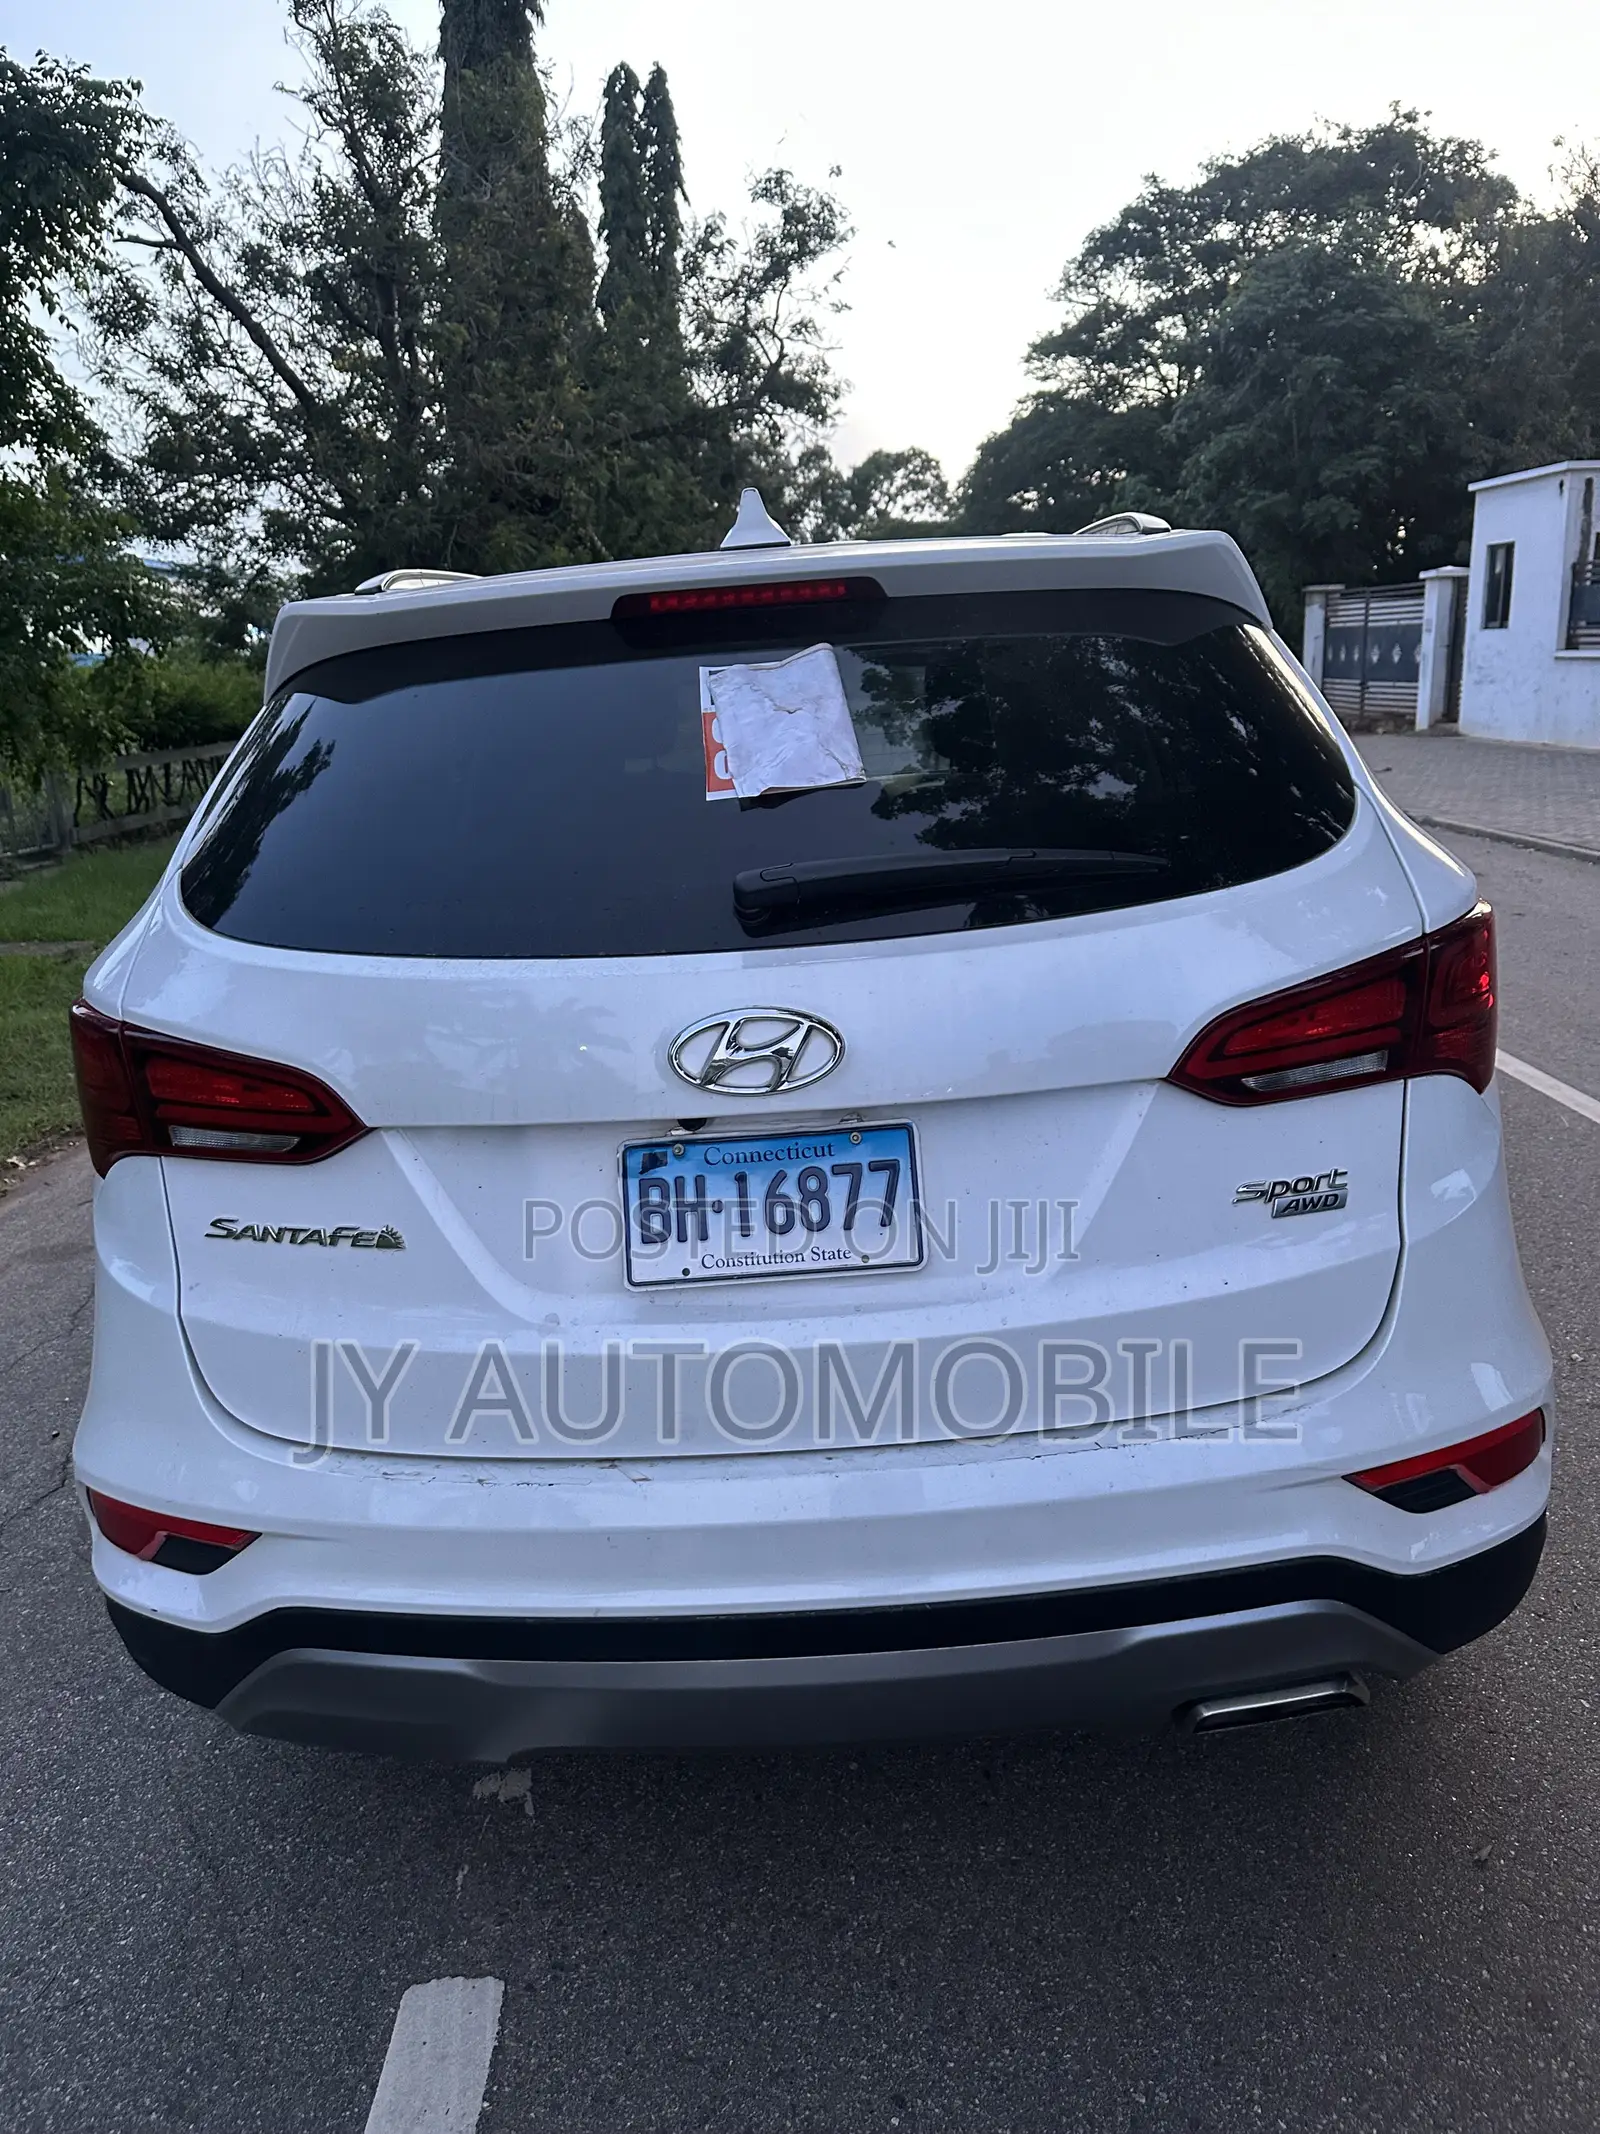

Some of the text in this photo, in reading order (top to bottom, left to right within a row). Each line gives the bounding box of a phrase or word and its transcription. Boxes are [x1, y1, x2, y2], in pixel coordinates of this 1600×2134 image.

[704, 1141, 835, 1167] Connecticut
[1232, 1168, 1348, 1204] Sport
[1281, 1193, 1340, 1214] AWD
[701, 1246, 851, 1270] Constitution State
